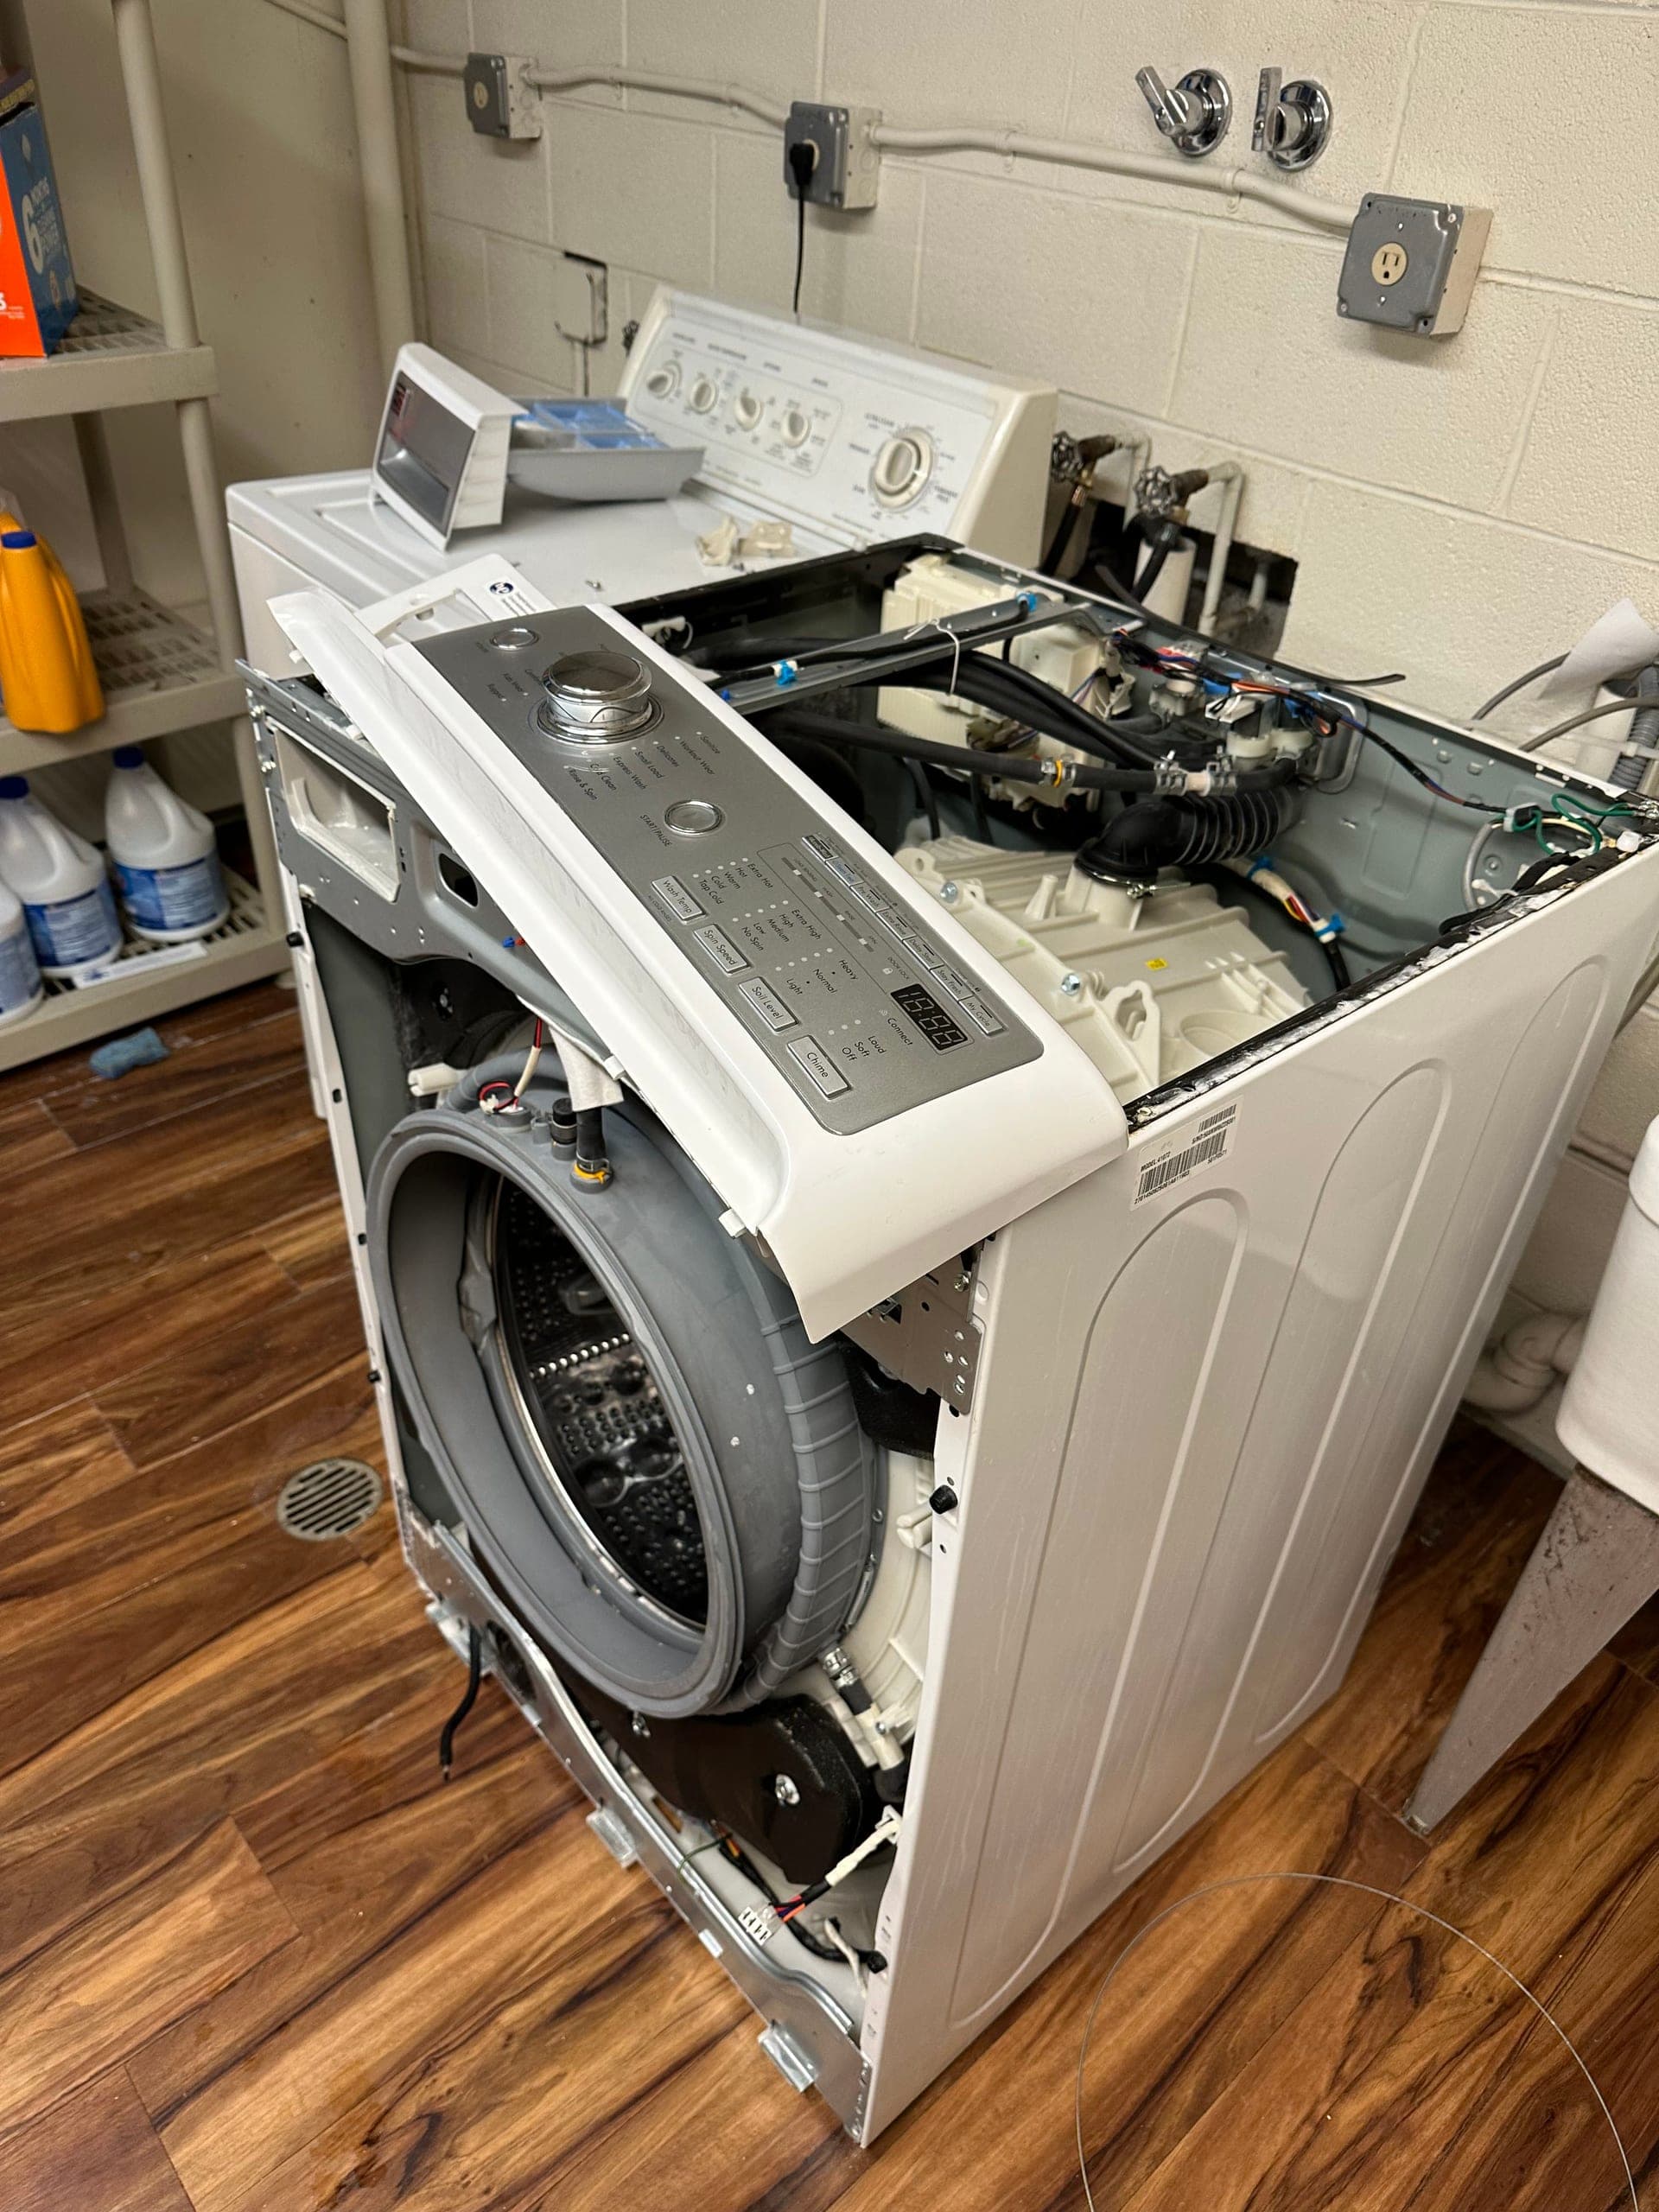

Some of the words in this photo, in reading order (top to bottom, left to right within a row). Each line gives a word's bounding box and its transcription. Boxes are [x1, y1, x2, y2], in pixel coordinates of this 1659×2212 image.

[711, 875, 727, 889] Cold
[724, 871, 741, 889] Warm
[735, 867, 747, 878] Hot
[747, 863, 763, 878] Extra
[761, 876, 774, 889] Hot
[663, 880, 678, 898] Wash
[677, 897, 692, 913] Temp
[699, 880, 710, 892] Tap
[709, 890, 724, 905] Cold
[753, 922, 766, 935] Low
[767, 918, 790, 943] Medium
[779, 913, 795, 928] High
[791, 909, 808, 925] Extra
[806, 925, 822, 940] High
[704, 929, 719, 944] Spin
[716, 944, 737, 965] Speed
[742, 926, 752, 938] No
[750, 937, 764, 951] Spin
[812, 968, 838, 995] Normal
[838, 959, 859, 980] Heavy
[786, 978, 803, 995] Light
[752, 986, 767, 1000] Soil
[763, 1000, 784, 1020] Level
[968, 1002, 976, 1011] My
[976, 1011, 990, 1027] Cycle
[868, 1035, 887, 1054] Loud
[887, 1018, 913, 1046] Connect
[842, 1046, 857, 1061] Off
[855, 1041, 870, 1057] Soft
[807, 1052, 829, 1078] Chime
